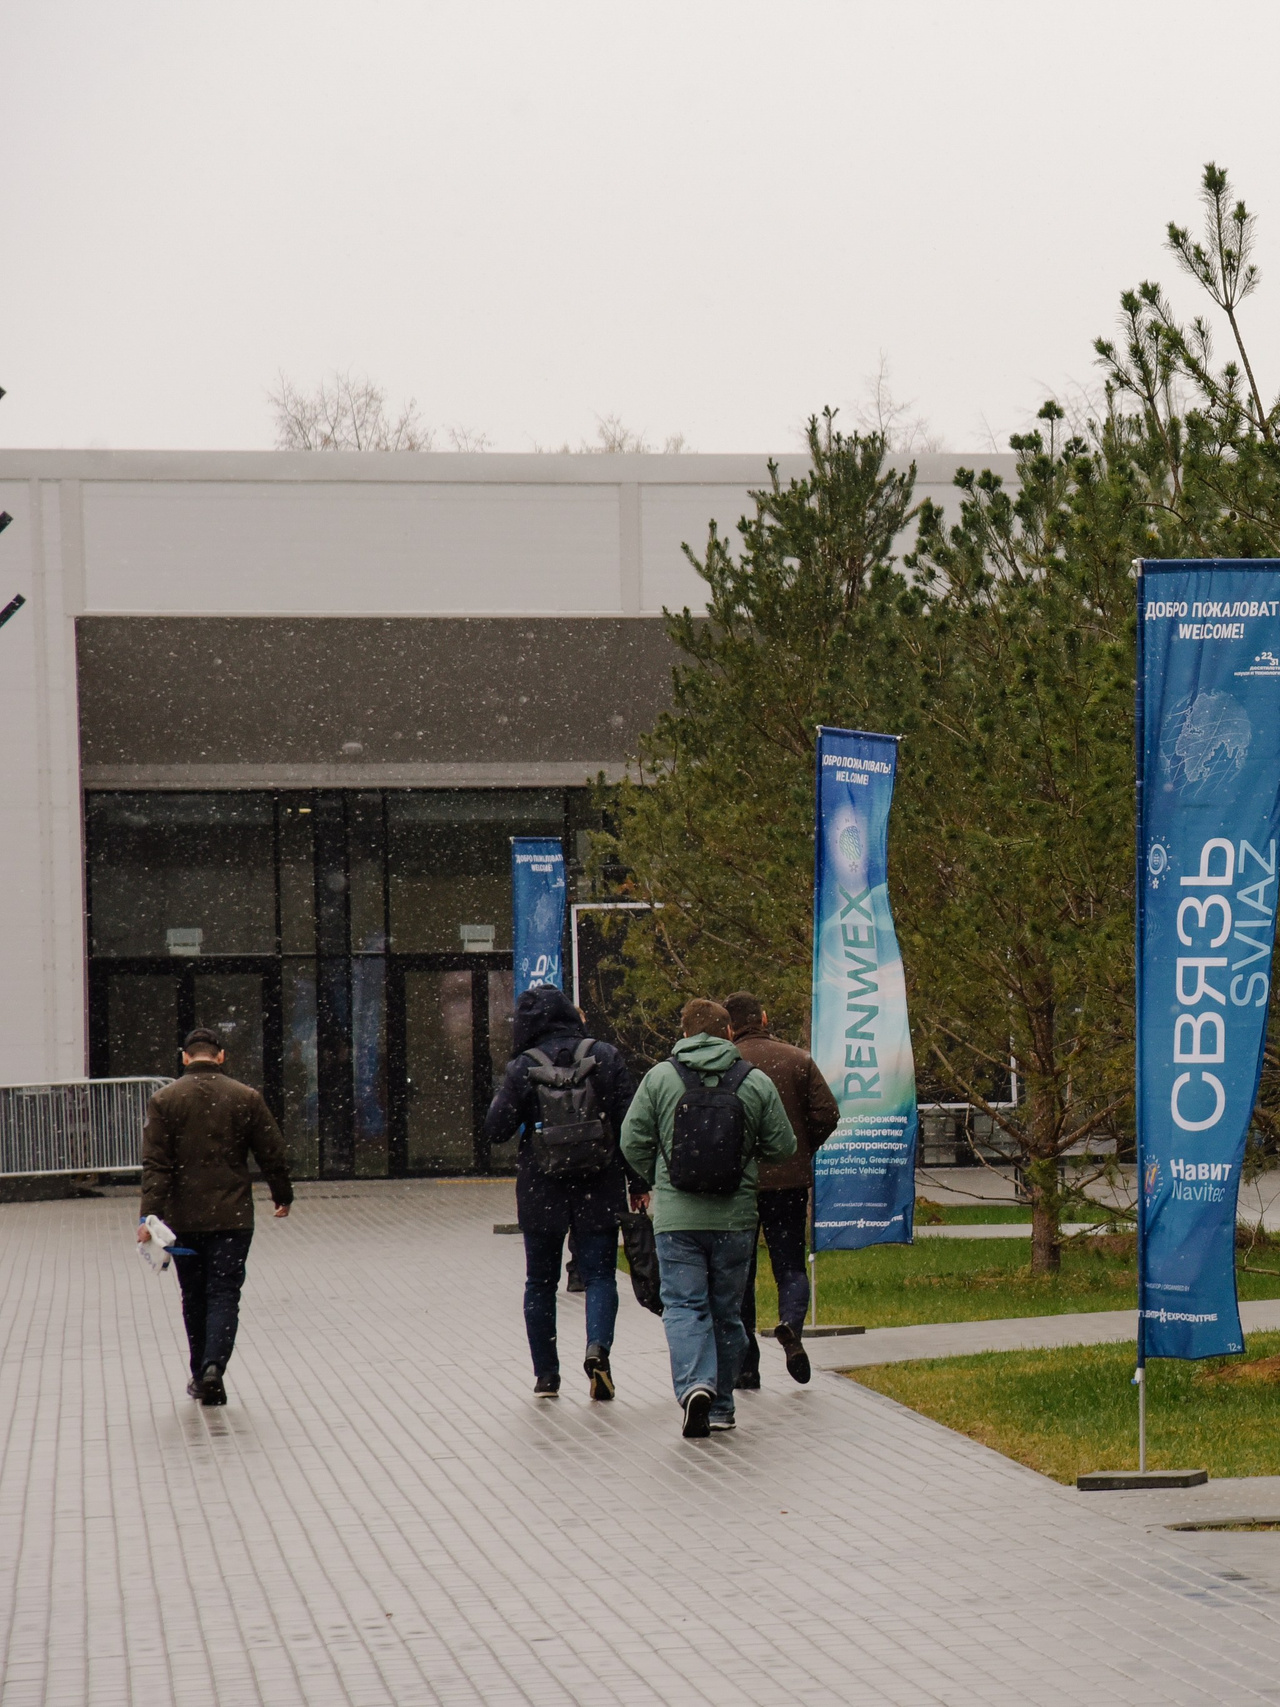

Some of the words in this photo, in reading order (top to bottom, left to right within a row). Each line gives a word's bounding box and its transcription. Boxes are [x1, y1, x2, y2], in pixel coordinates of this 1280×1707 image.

[1145, 601, 1188, 621] ДОБРО
[1179, 623, 1245, 640] WELCOME!
[1261, 651, 1273, 660] 22
[822, 754, 842, 768] ОБРО
[1230, 839, 1276, 1008] SVIAZ
[838, 883, 882, 1100] RENWEX
[1171, 837, 1235, 1132] СВЯЗЬ
[830, 1167, 857, 1175] Electric
[1167, 1312, 1218, 1323] EXPOCENTRE
